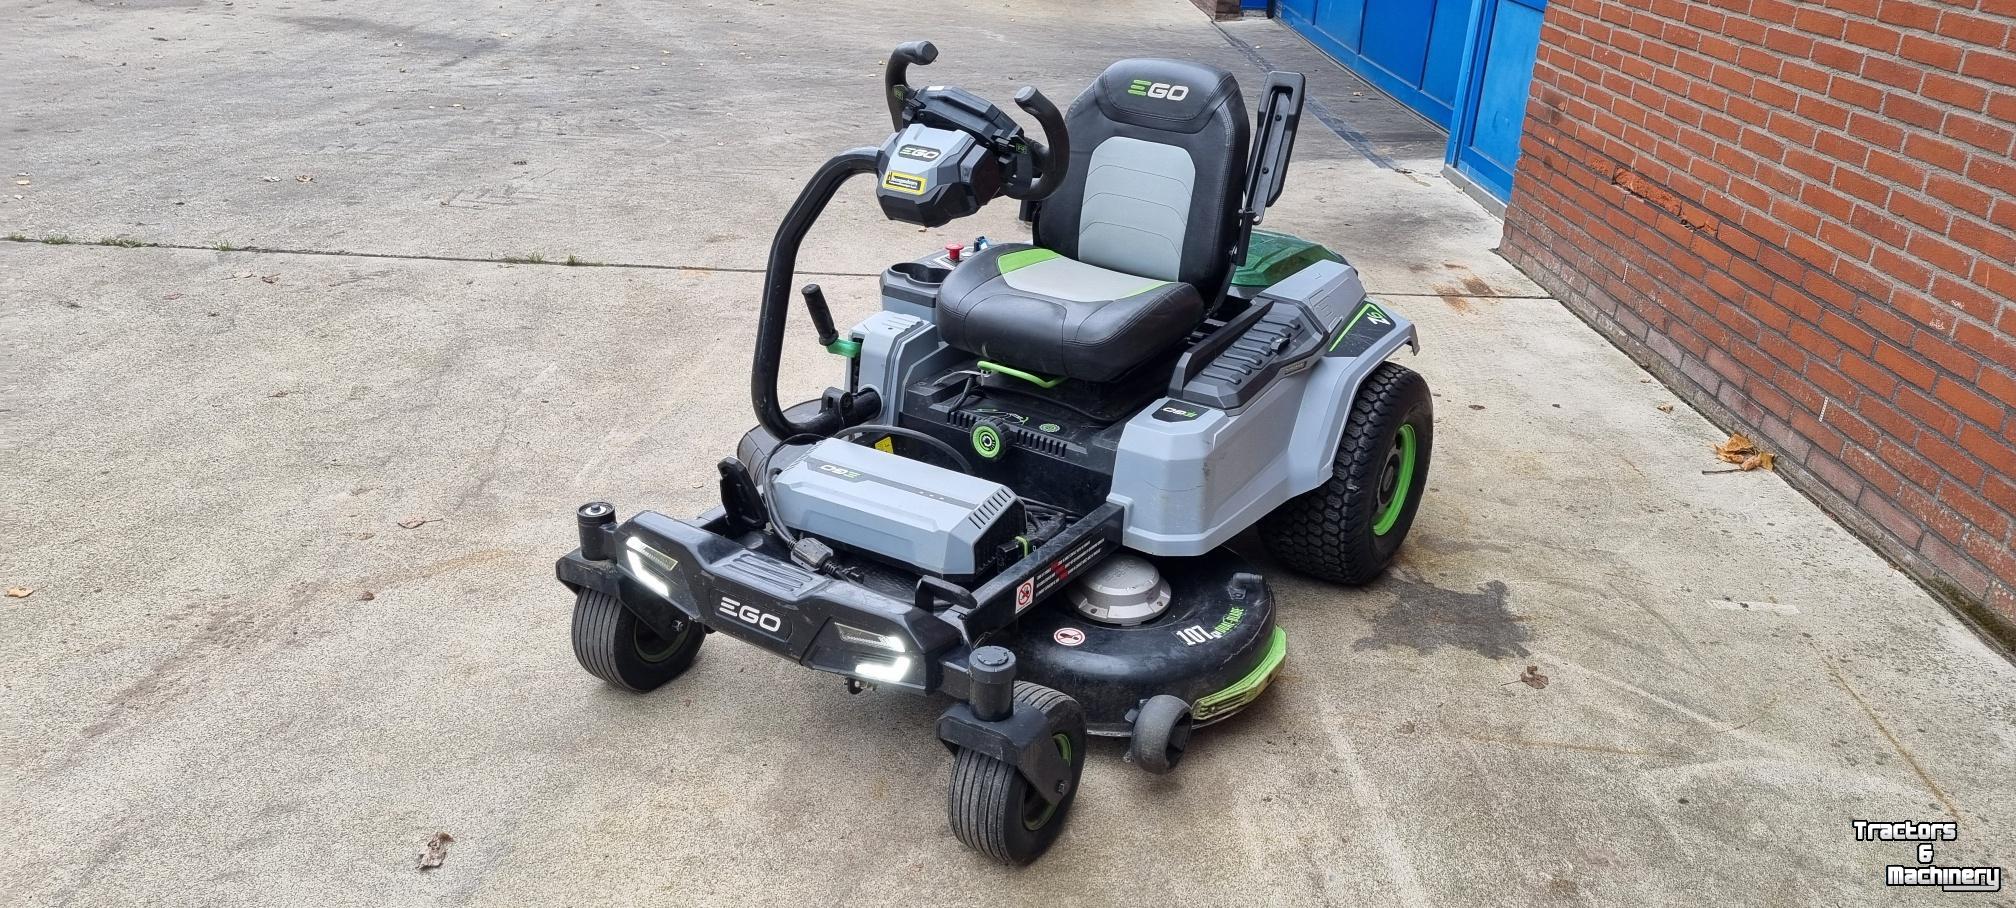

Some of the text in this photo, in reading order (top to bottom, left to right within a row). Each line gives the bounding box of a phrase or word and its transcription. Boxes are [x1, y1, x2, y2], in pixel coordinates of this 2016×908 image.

[1127, 79, 1189, 101] EGO
[899, 146, 940, 160] EGO
[820, 464, 861, 479] EGO
[719, 596, 781, 632] EGO
[1176, 624, 1214, 646] 107
